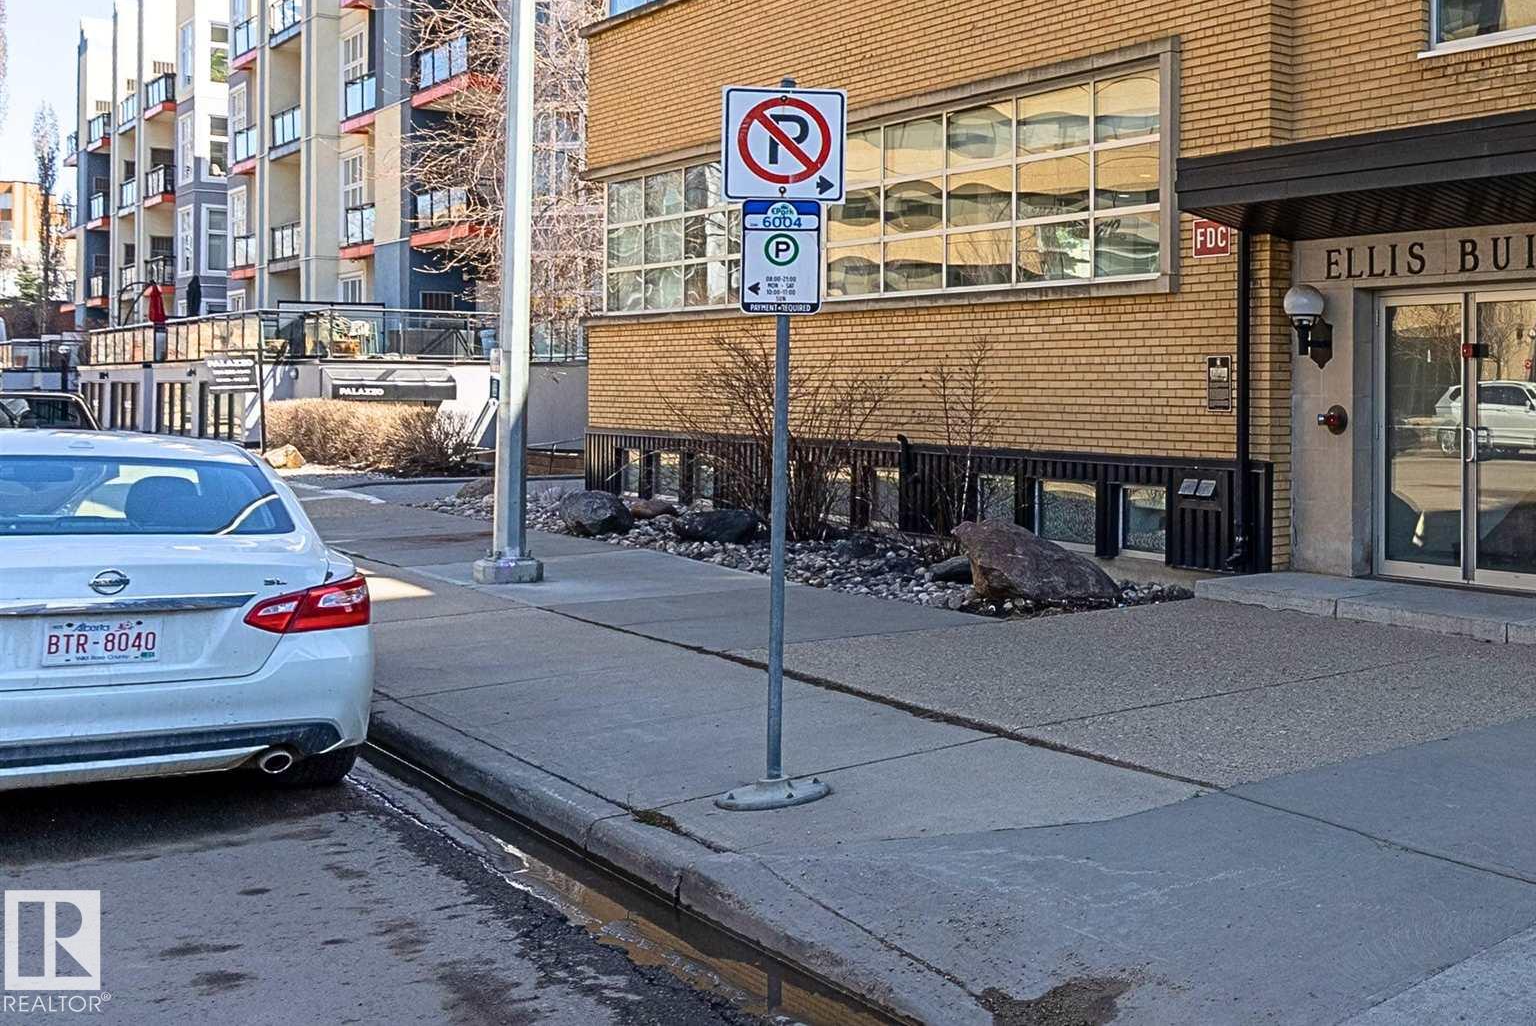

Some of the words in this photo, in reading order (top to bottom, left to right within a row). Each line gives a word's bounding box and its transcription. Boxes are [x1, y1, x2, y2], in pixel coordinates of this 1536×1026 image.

[769, 114, 809, 165] P
[762, 216, 802, 228] 6004
[1196, 226, 1226, 249] FDC
[774, 241, 791, 259] P
[1325, 242, 1426, 280] ELLIS
[750, 304, 778, 312] PAYMENT
[781, 304, 811, 312] REQUIRED
[47, 632, 156, 655] BTR-8040
